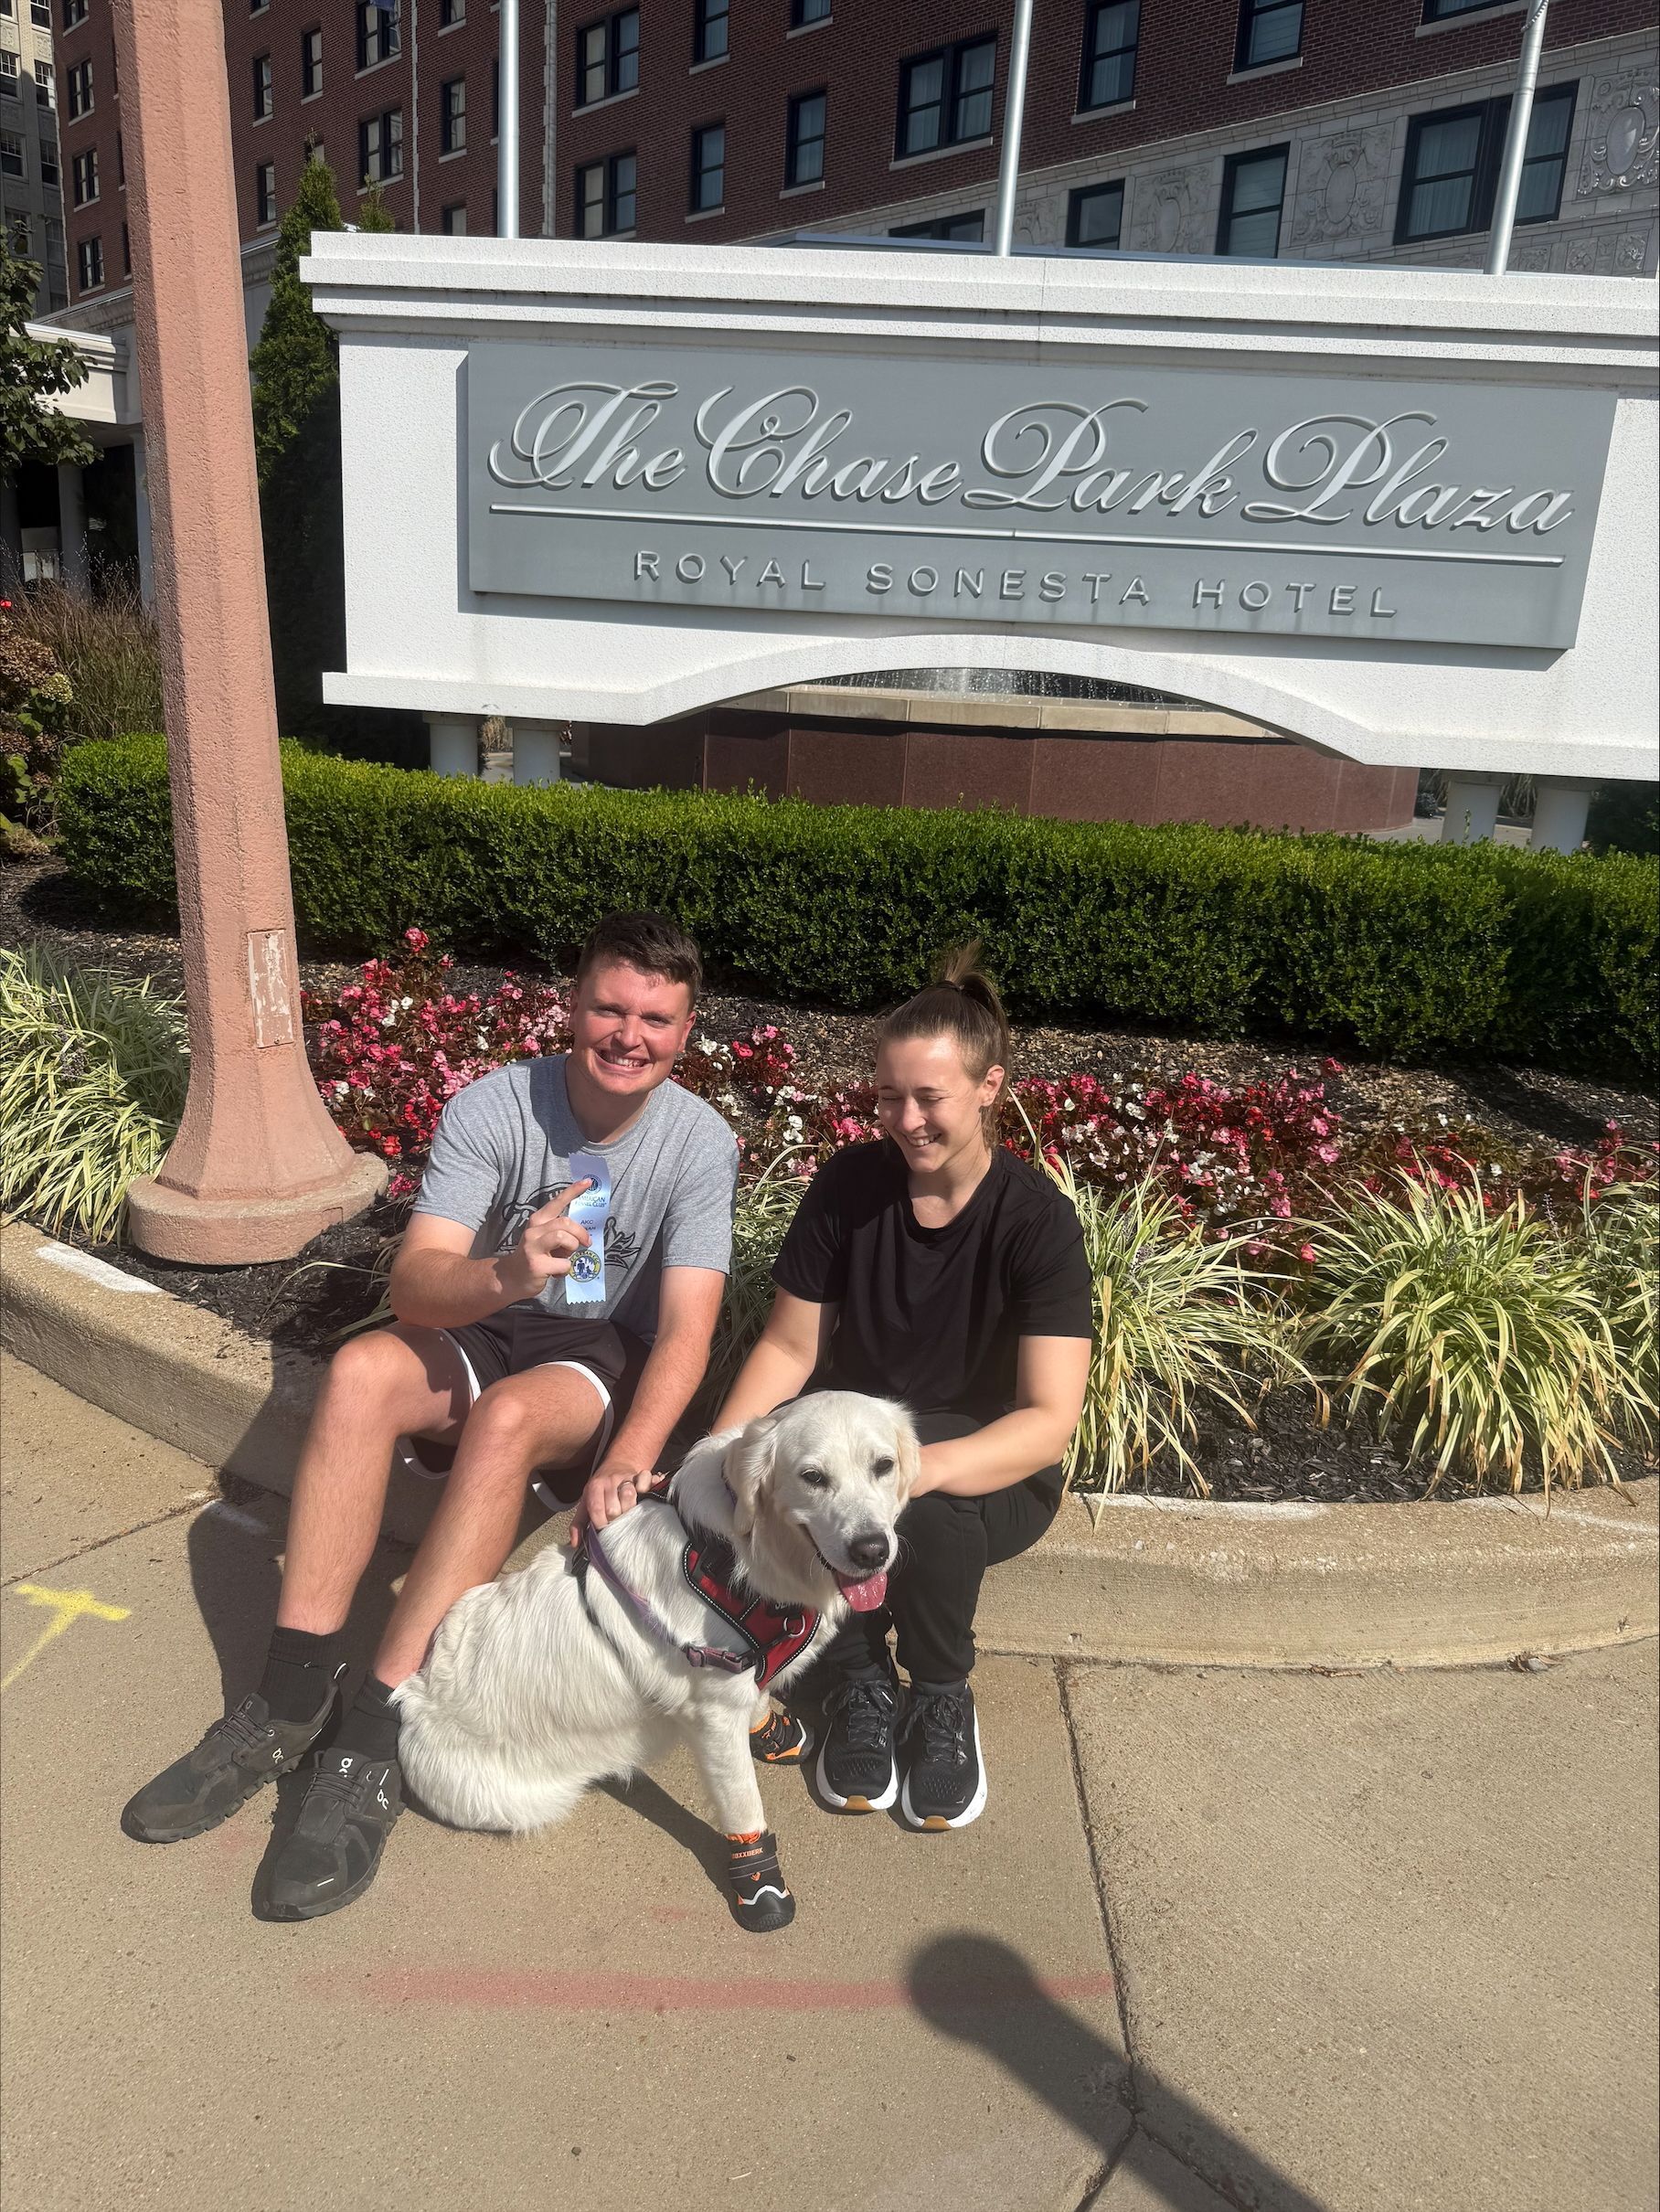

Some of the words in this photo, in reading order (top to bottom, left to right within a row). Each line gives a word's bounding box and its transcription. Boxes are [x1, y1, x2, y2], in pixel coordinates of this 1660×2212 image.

[487, 380, 687, 490] The
[694, 385, 963, 502] Chase
[960, 399, 1258, 516] Park
[1241, 410, 1577, 534] Plaza
[634, 550, 826, 590] ROYAL
[866, 562, 1150, 605] SONESTA
[1192, 578, 1398, 619] HOTEL
